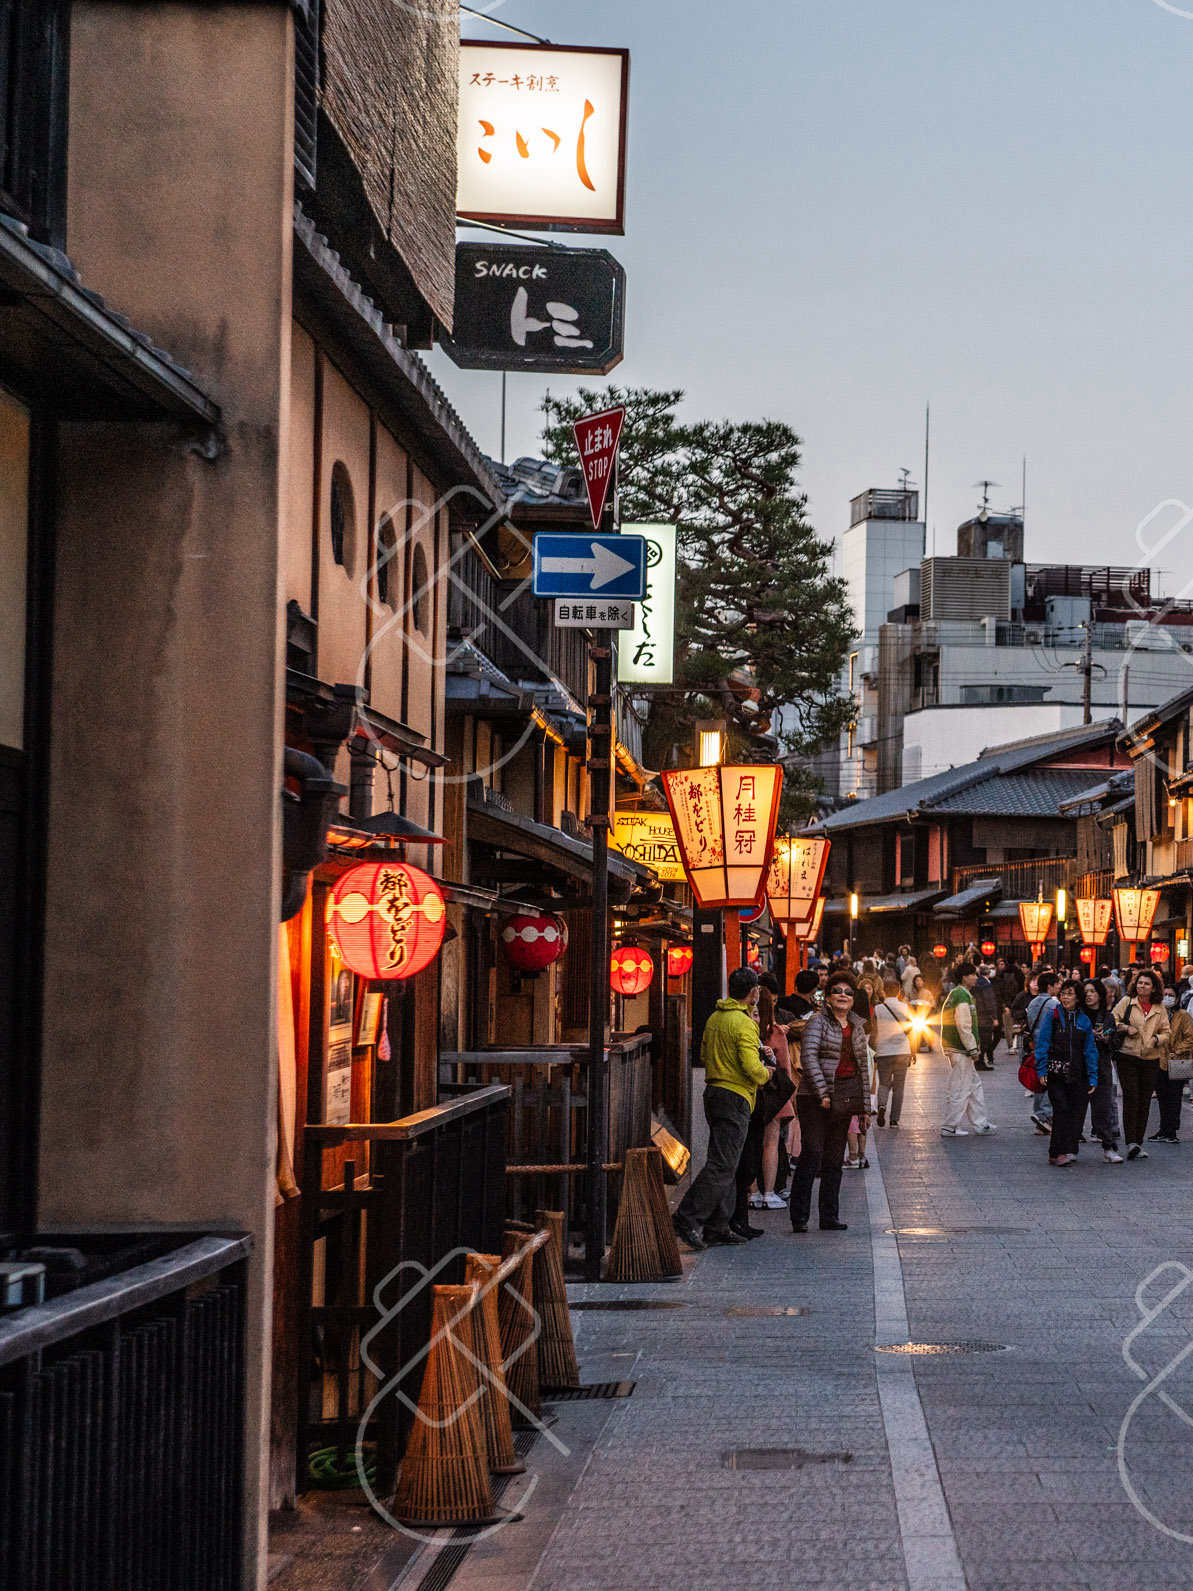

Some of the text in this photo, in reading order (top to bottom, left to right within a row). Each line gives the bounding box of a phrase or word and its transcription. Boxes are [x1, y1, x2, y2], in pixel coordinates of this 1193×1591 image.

[468, 72, 560, 92] ステーキ割烹
[477, 99, 597, 192] こいし
[474, 260, 549, 280] SNACK
[510, 285, 594, 348] トミ
[583, 423, 614, 456] 止まれ
[588, 456, 609, 482] STOP
[558, 605, 629, 621] 自転車を除く
[616, 817, 648, 827] STEAK
[688, 781, 708, 853] 都をどり
[732, 775, 757, 854] 月桂冠
[615, 842, 679, 862] YOSHIDA
[379, 869, 413, 970] 都をどり
